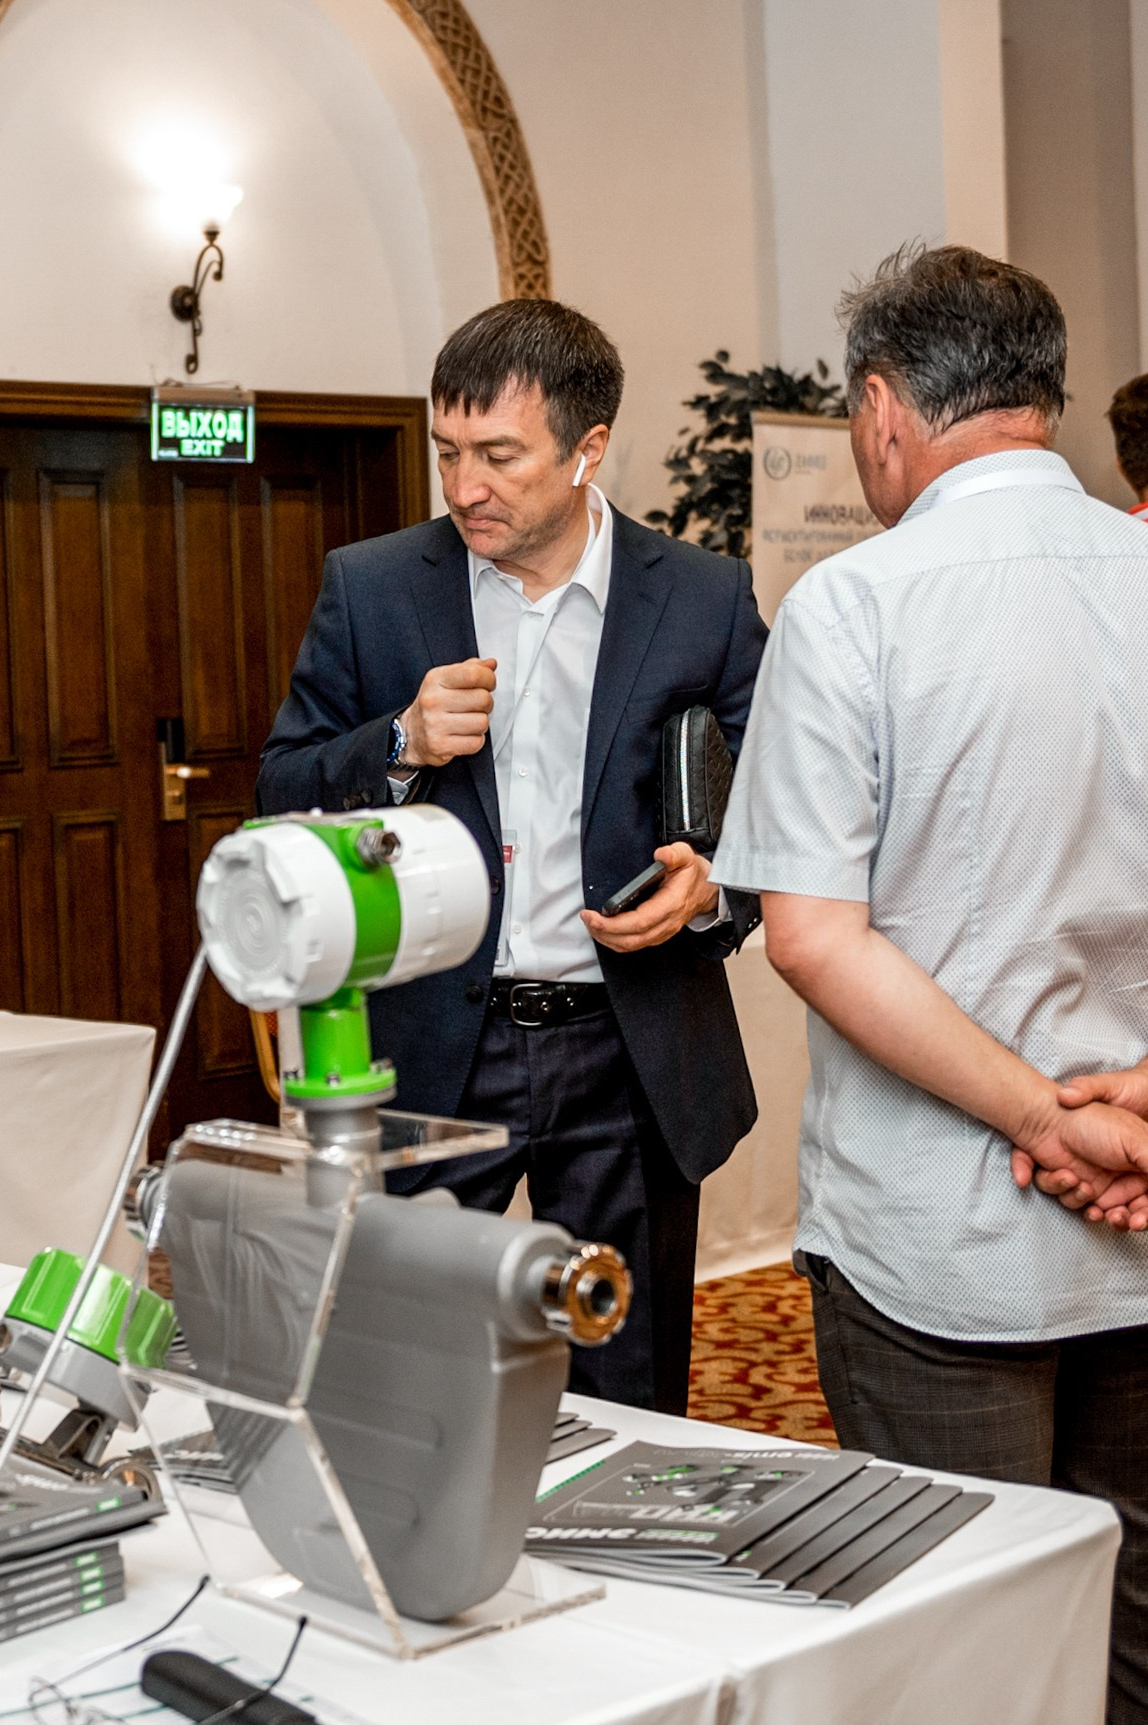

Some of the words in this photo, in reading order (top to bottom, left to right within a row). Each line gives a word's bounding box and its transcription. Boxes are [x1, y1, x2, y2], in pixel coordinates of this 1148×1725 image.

[161, 410, 244, 443] ВЫХОД
[180, 439, 224, 457] EXIT
[525, 1526, 637, 1540] ЭМИС
